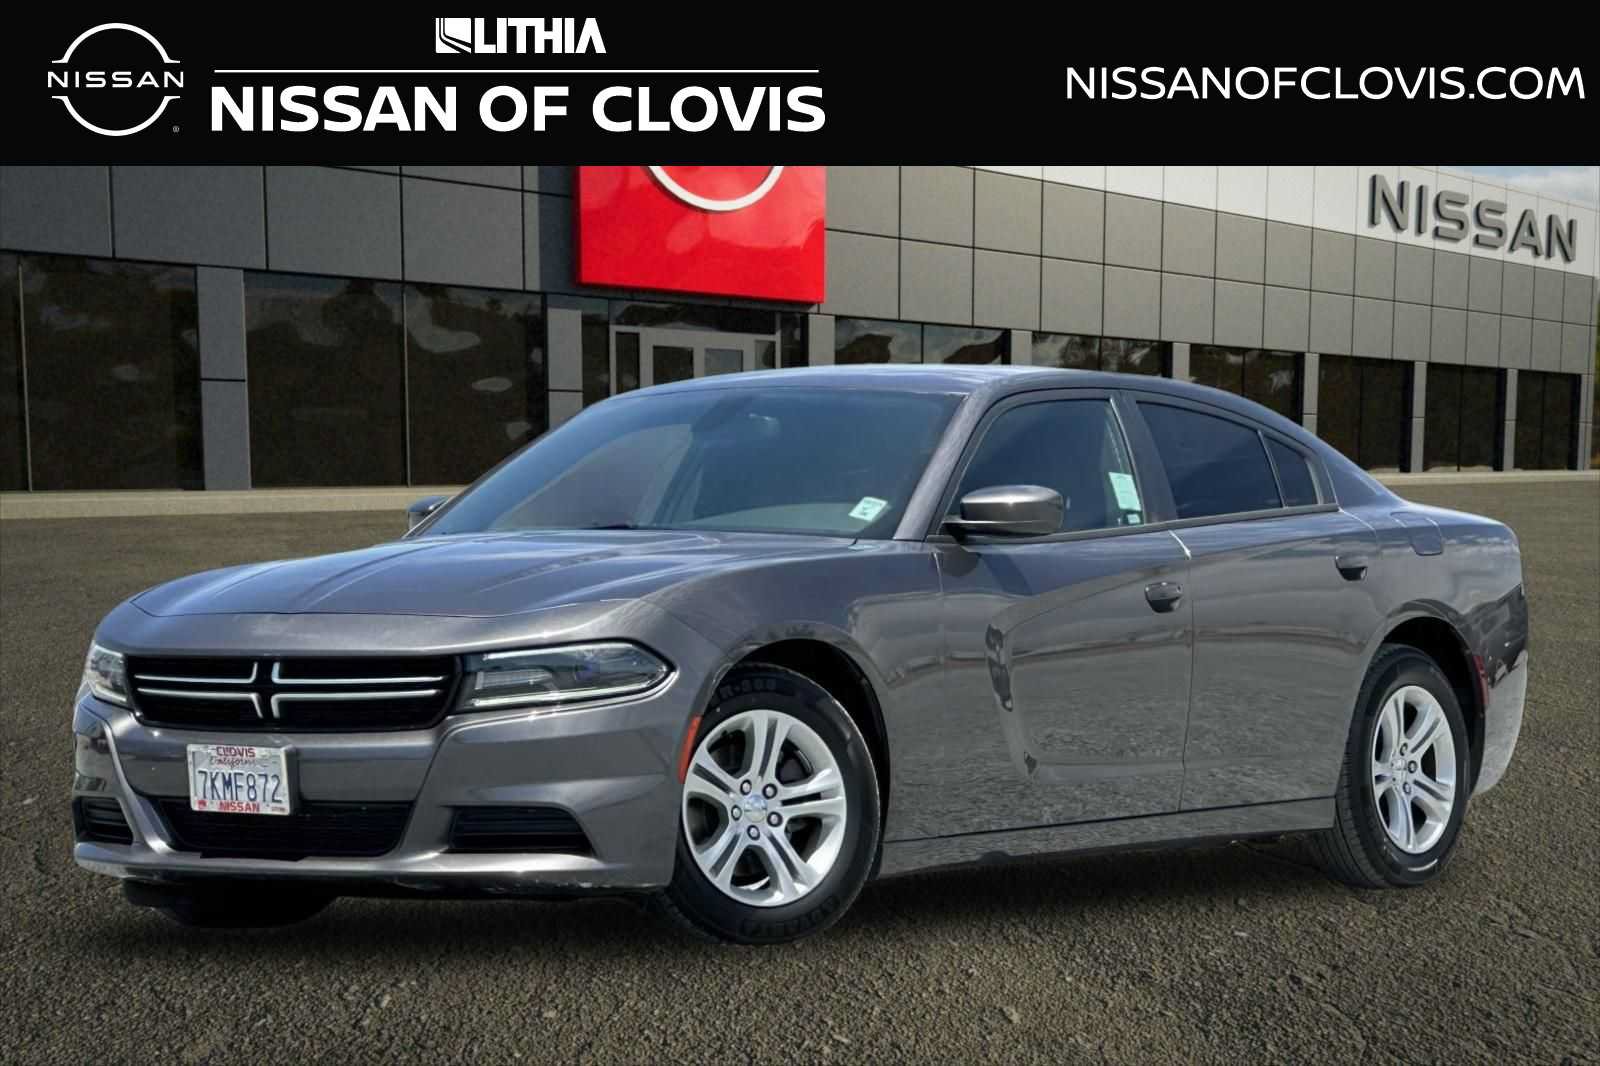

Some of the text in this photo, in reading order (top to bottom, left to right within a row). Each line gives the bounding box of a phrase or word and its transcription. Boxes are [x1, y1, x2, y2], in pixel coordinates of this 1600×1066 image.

[1368, 173, 1577, 264] NISSAN
[216, 746, 256, 758] CLOVIS
[198, 770, 282, 803] 7KMF872
[219, 801, 260, 812] NISSAN
